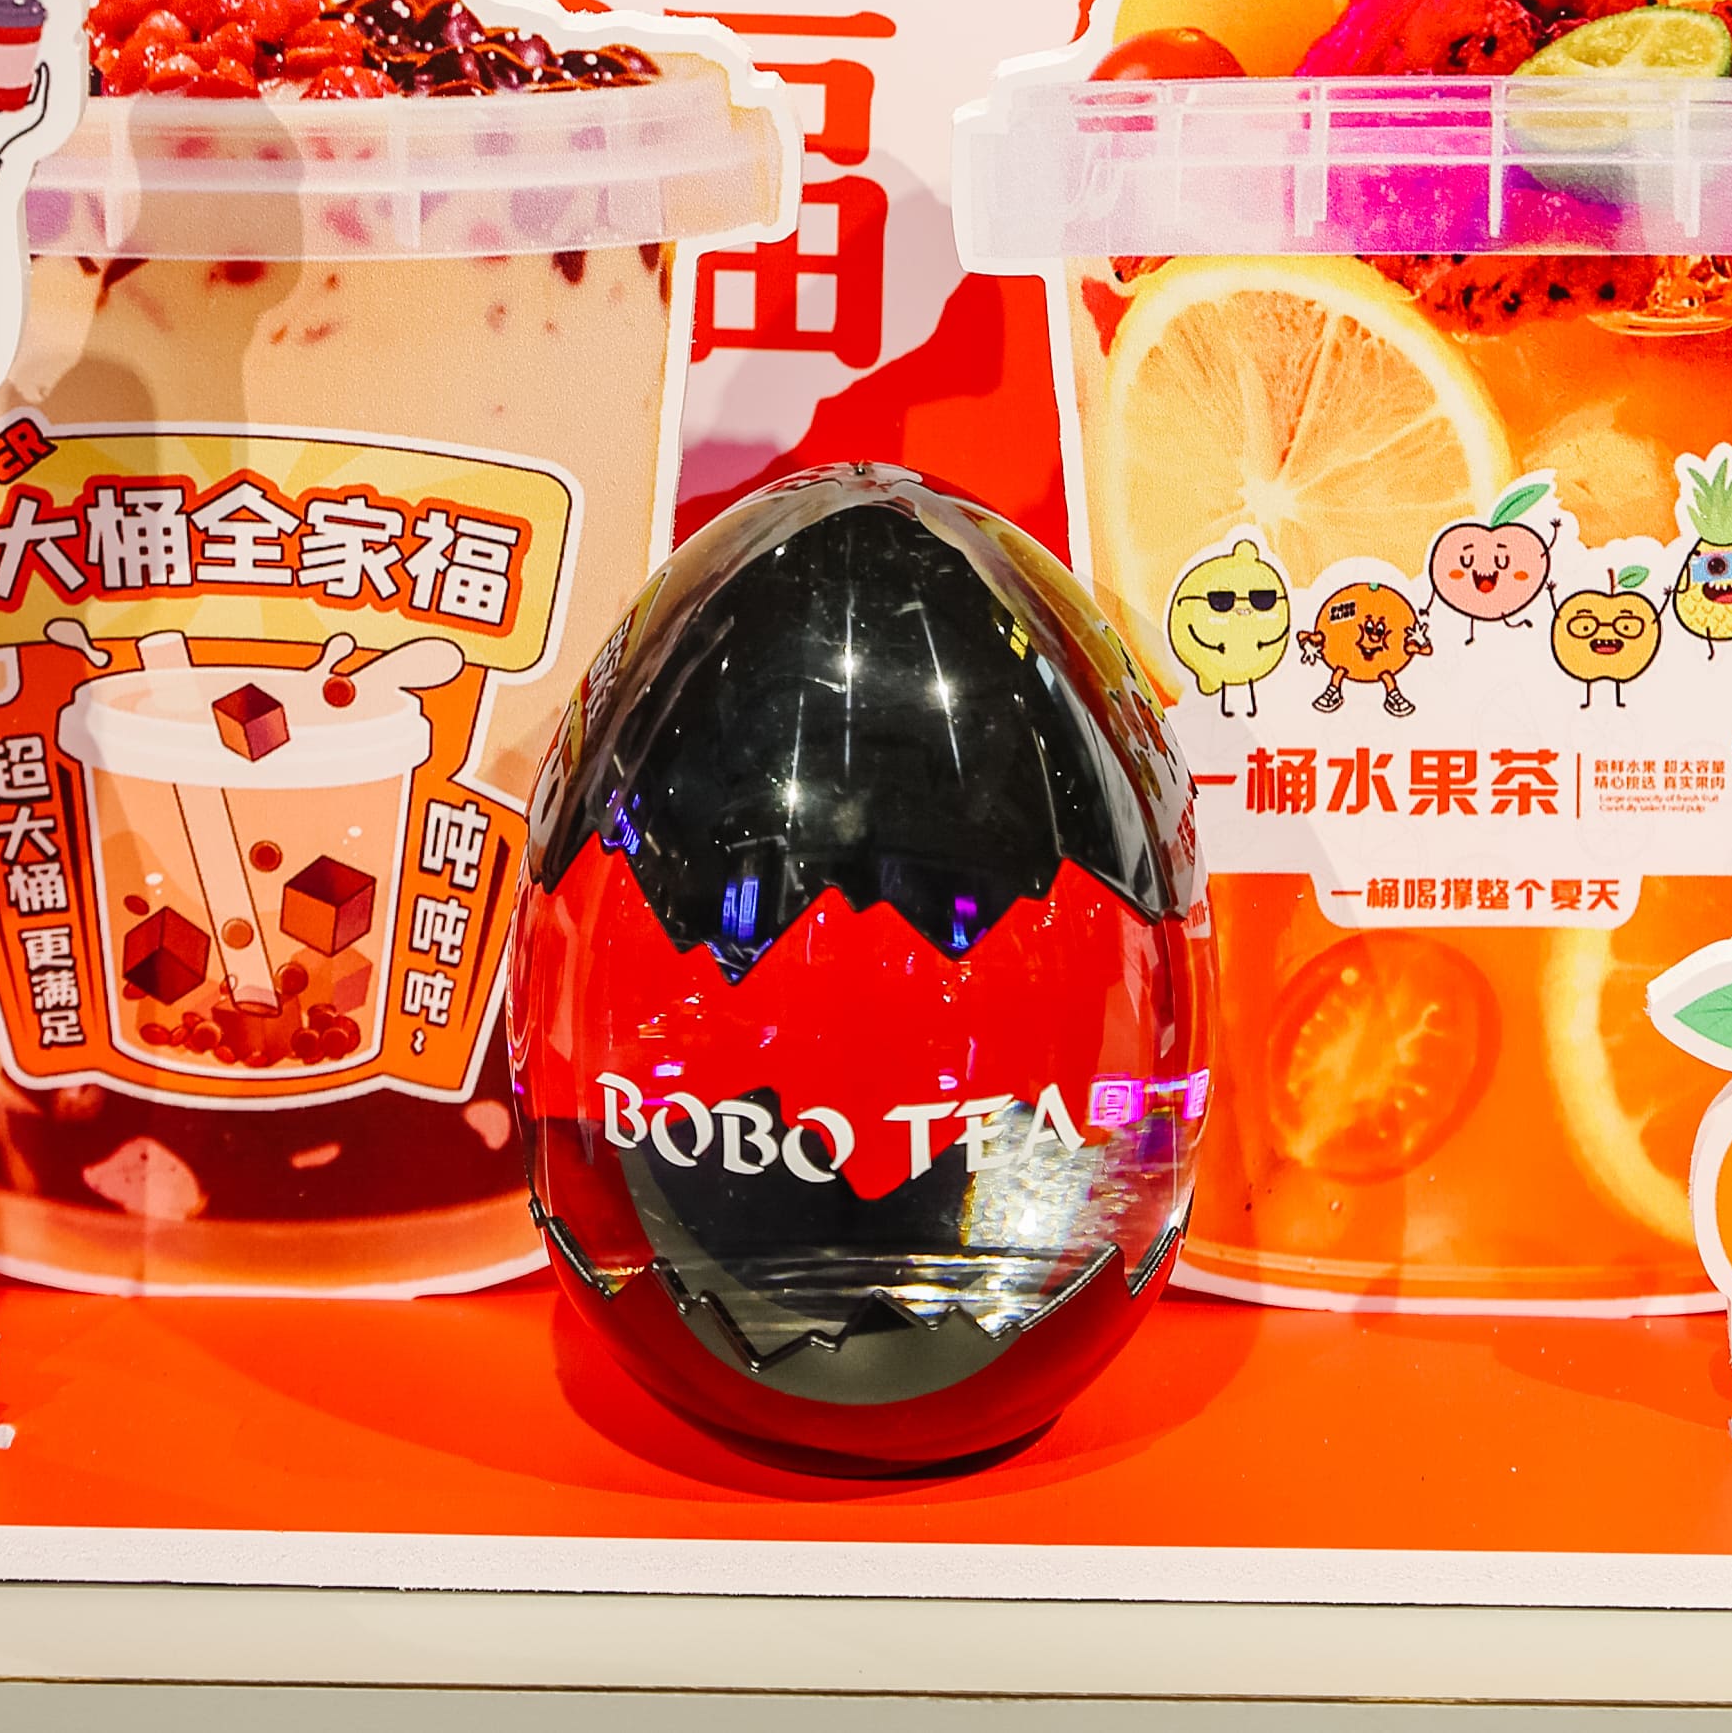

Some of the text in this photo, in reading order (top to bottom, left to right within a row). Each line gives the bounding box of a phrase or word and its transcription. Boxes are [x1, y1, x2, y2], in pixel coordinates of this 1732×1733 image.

[1190, 747, 1561, 818] 一桶水果茶
[1331, 878, 1619, 910] 一桶喝撑整个夏天
[20, 928, 85, 1049] 更满足
[596, 1071, 1086, 1183] BOBO TEA
